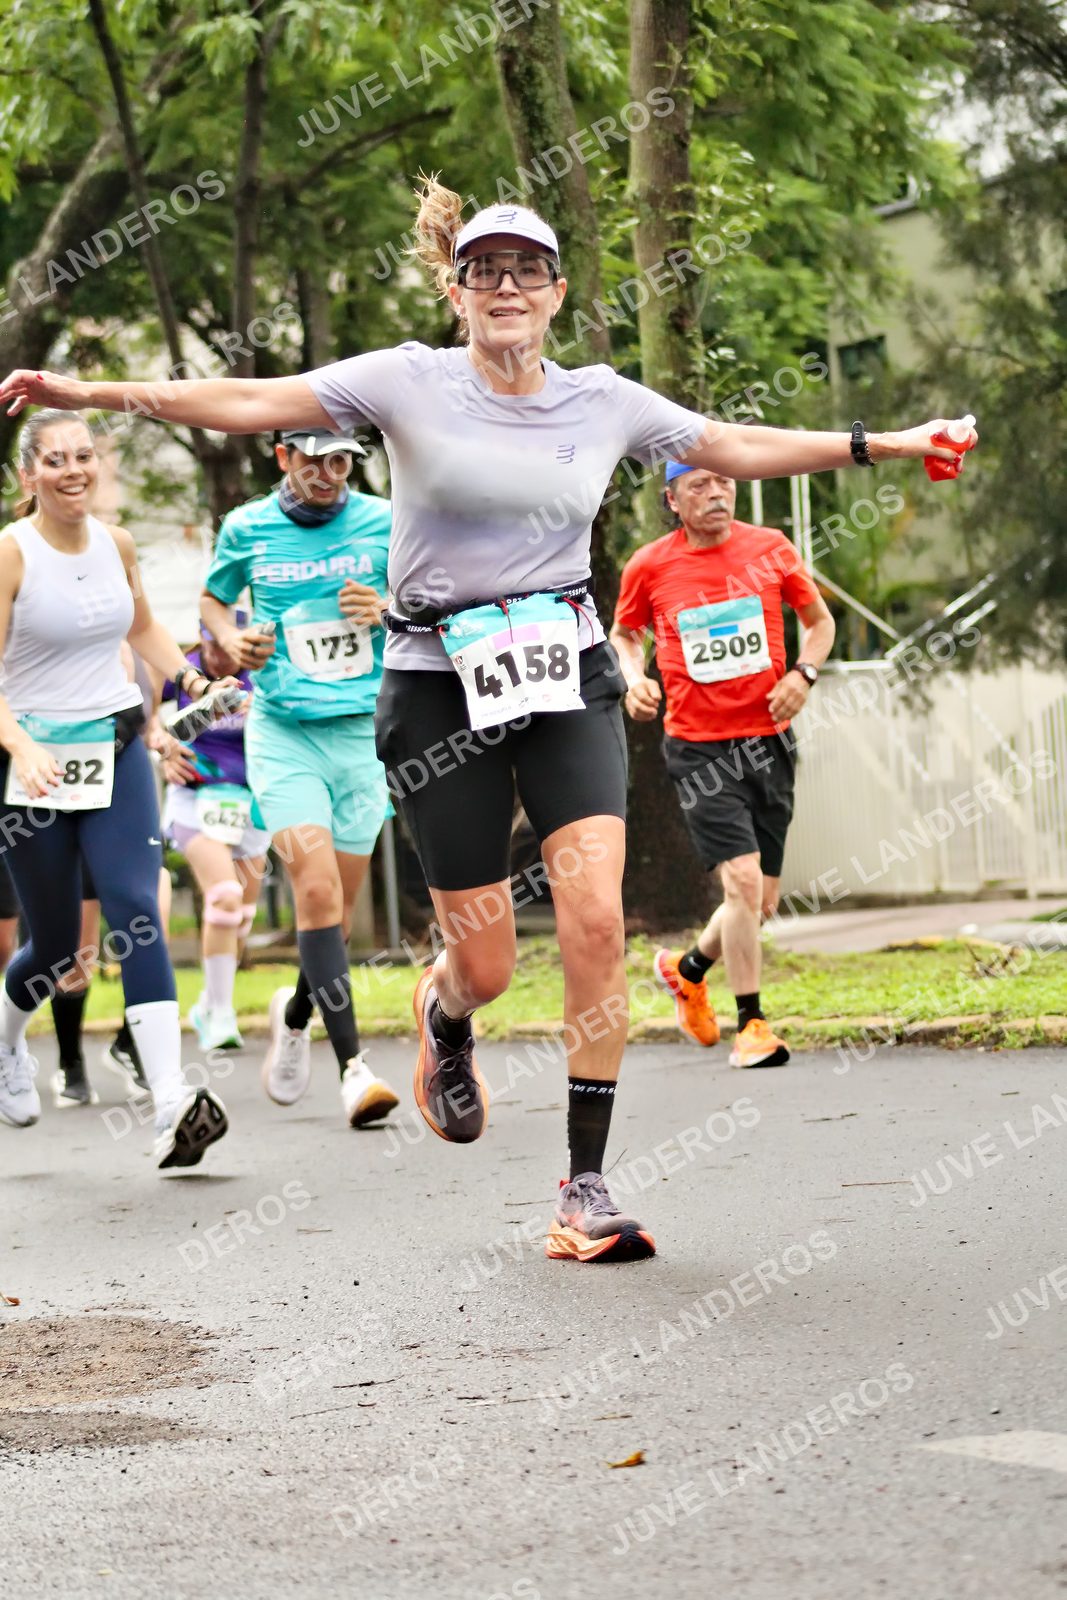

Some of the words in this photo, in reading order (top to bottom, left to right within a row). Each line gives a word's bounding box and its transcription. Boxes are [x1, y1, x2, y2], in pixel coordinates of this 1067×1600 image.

[252, 554, 373, 582] PERDURA
[306, 632, 360, 662] 173
[691, 632, 762, 665] 2909
[474, 643, 571, 699] 4158
